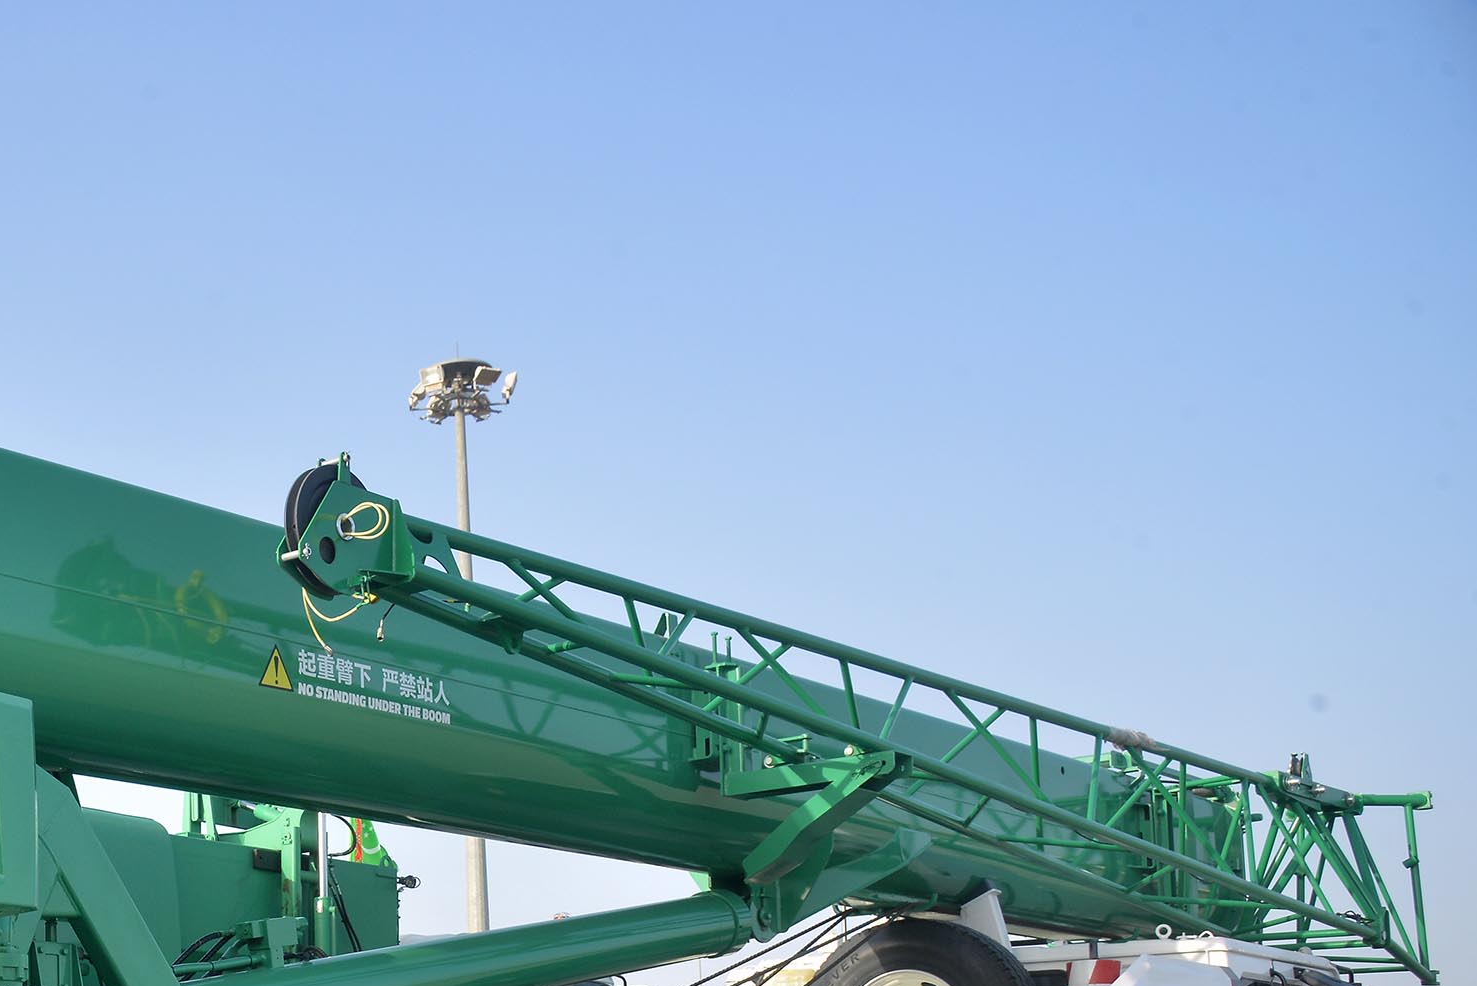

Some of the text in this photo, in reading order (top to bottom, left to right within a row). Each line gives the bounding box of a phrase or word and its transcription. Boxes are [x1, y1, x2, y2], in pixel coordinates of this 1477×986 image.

[298, 649, 450, 706] 起重臂下 严禁站人
[298, 682, 451, 725] NO STANDING UNDER THE BOOM
